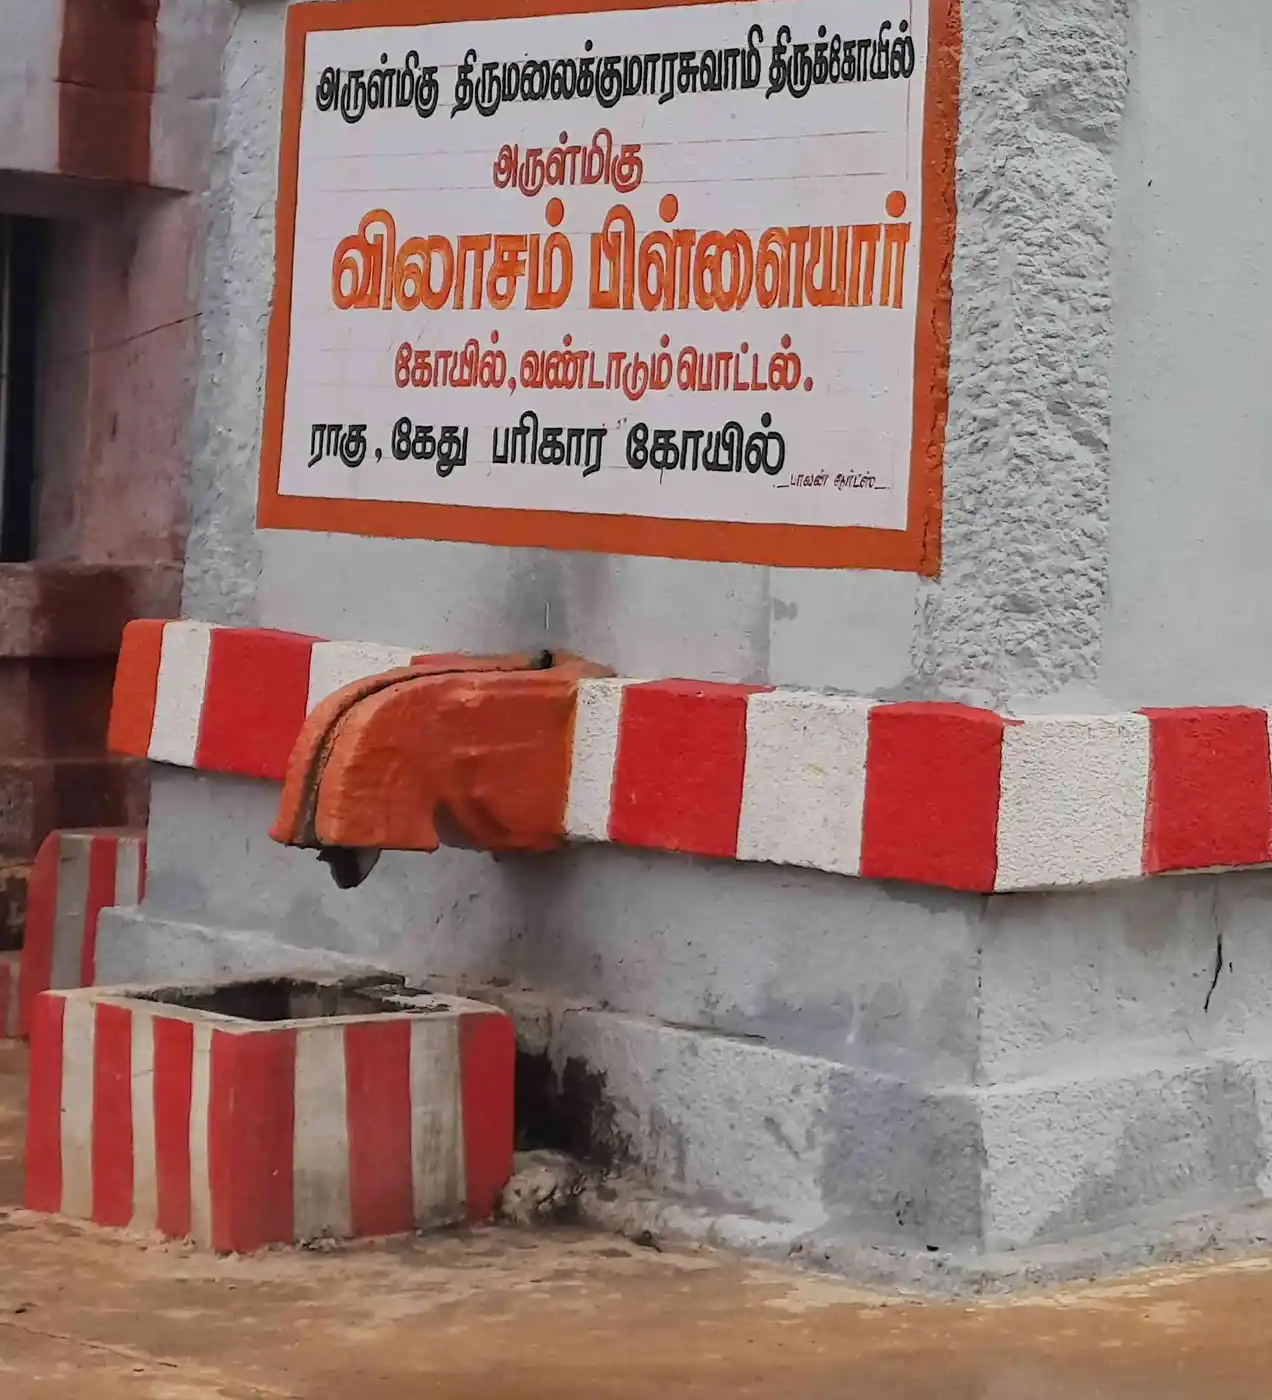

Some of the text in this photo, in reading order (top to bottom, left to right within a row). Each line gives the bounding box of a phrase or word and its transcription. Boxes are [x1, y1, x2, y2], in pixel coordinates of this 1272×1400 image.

[316, 19, 915, 124] அருள்மிகு திருமலைக்குமாரசுவாமி திருக்கோயில்
[493, 127, 642, 196] அருள்மிகு
[332, 190, 911, 311] விலாசம் பிள்ளையார்
[391, 416, 468, 477] கேது
[492, 410, 607, 477] பரிகார
[626, 412, 786, 475] கோயில்
